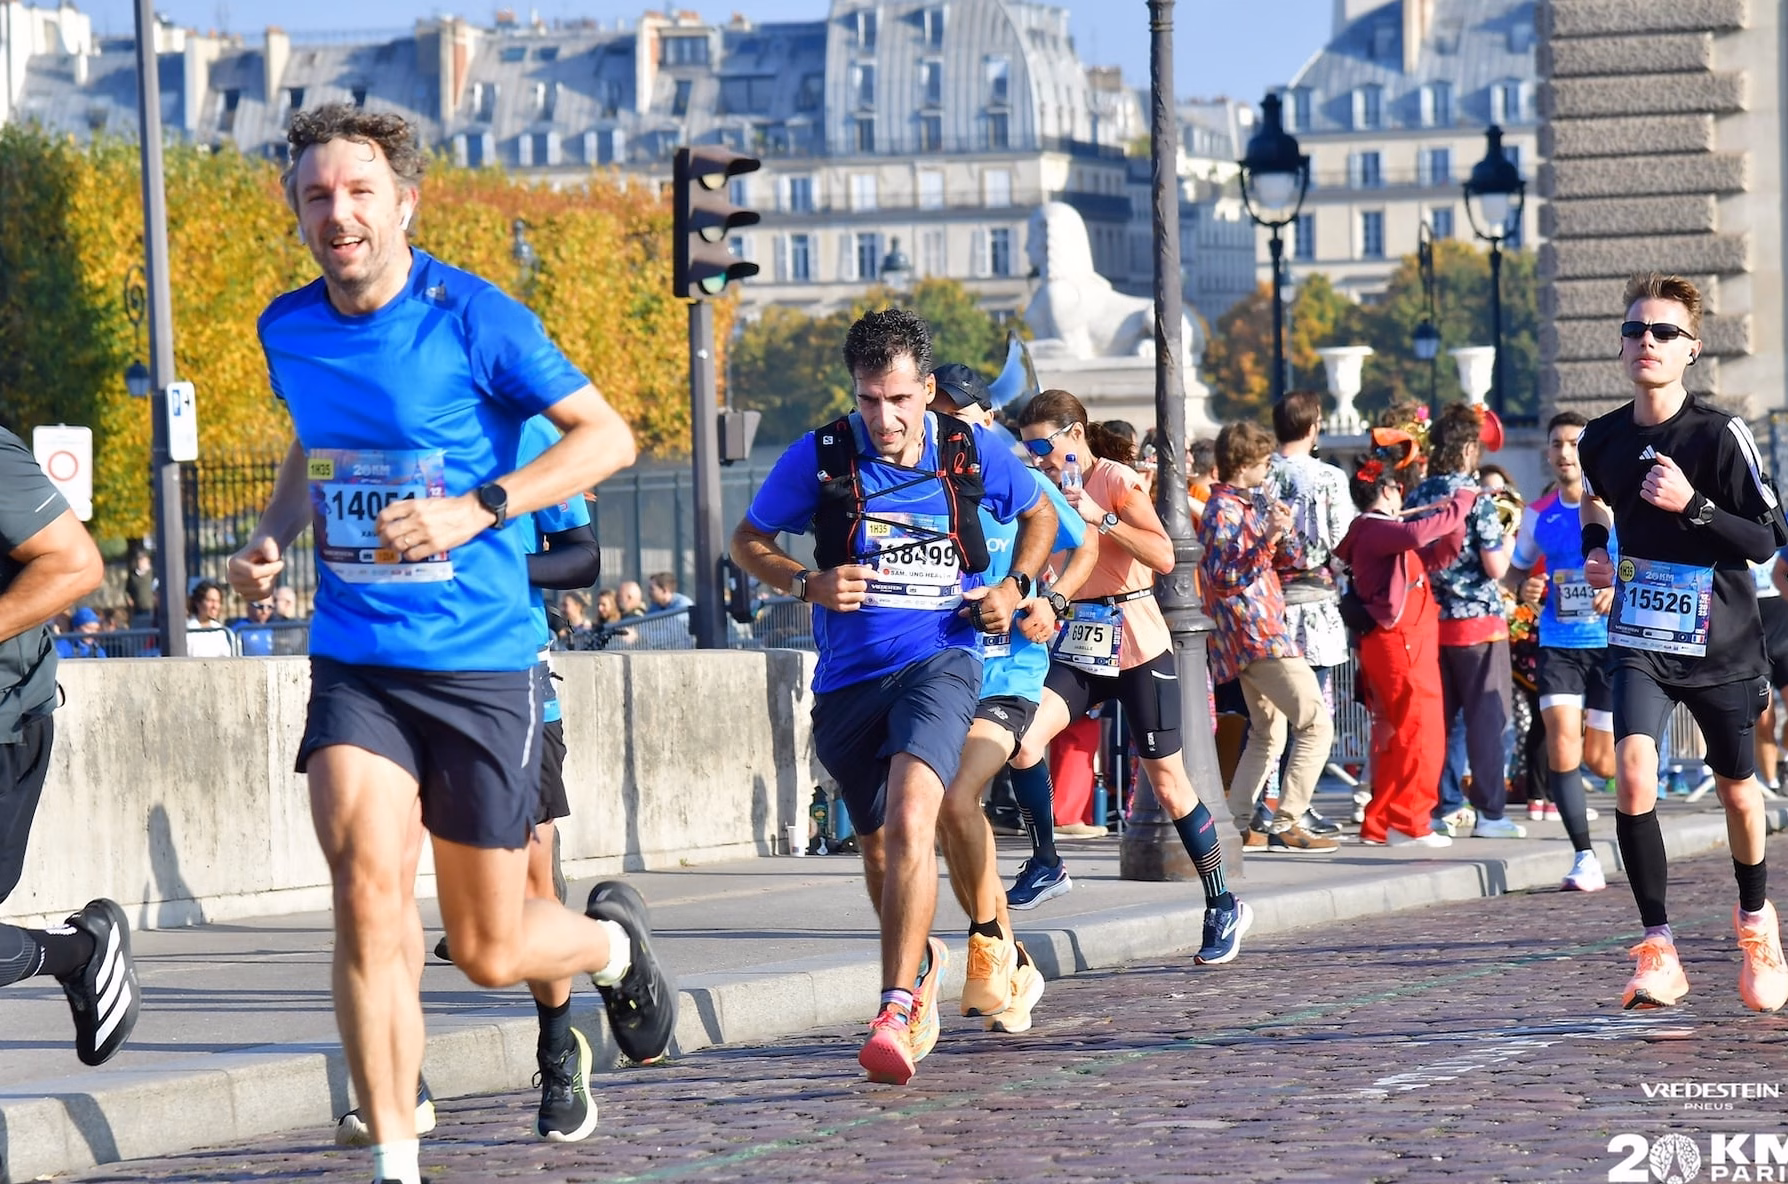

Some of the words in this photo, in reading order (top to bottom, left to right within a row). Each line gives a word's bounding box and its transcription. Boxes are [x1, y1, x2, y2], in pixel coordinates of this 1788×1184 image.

[311, 464, 331, 475] 1H35
[332, 490, 415, 521] 140
[869, 524, 888, 534] 1H35
[890, 570, 924, 578] SAMUNG
[1620, 564, 1633, 577] 1H35
[1564, 586, 1601, 599] 3443
[1629, 587, 1692, 615] 15526
[1072, 625, 1103, 643] 6975
